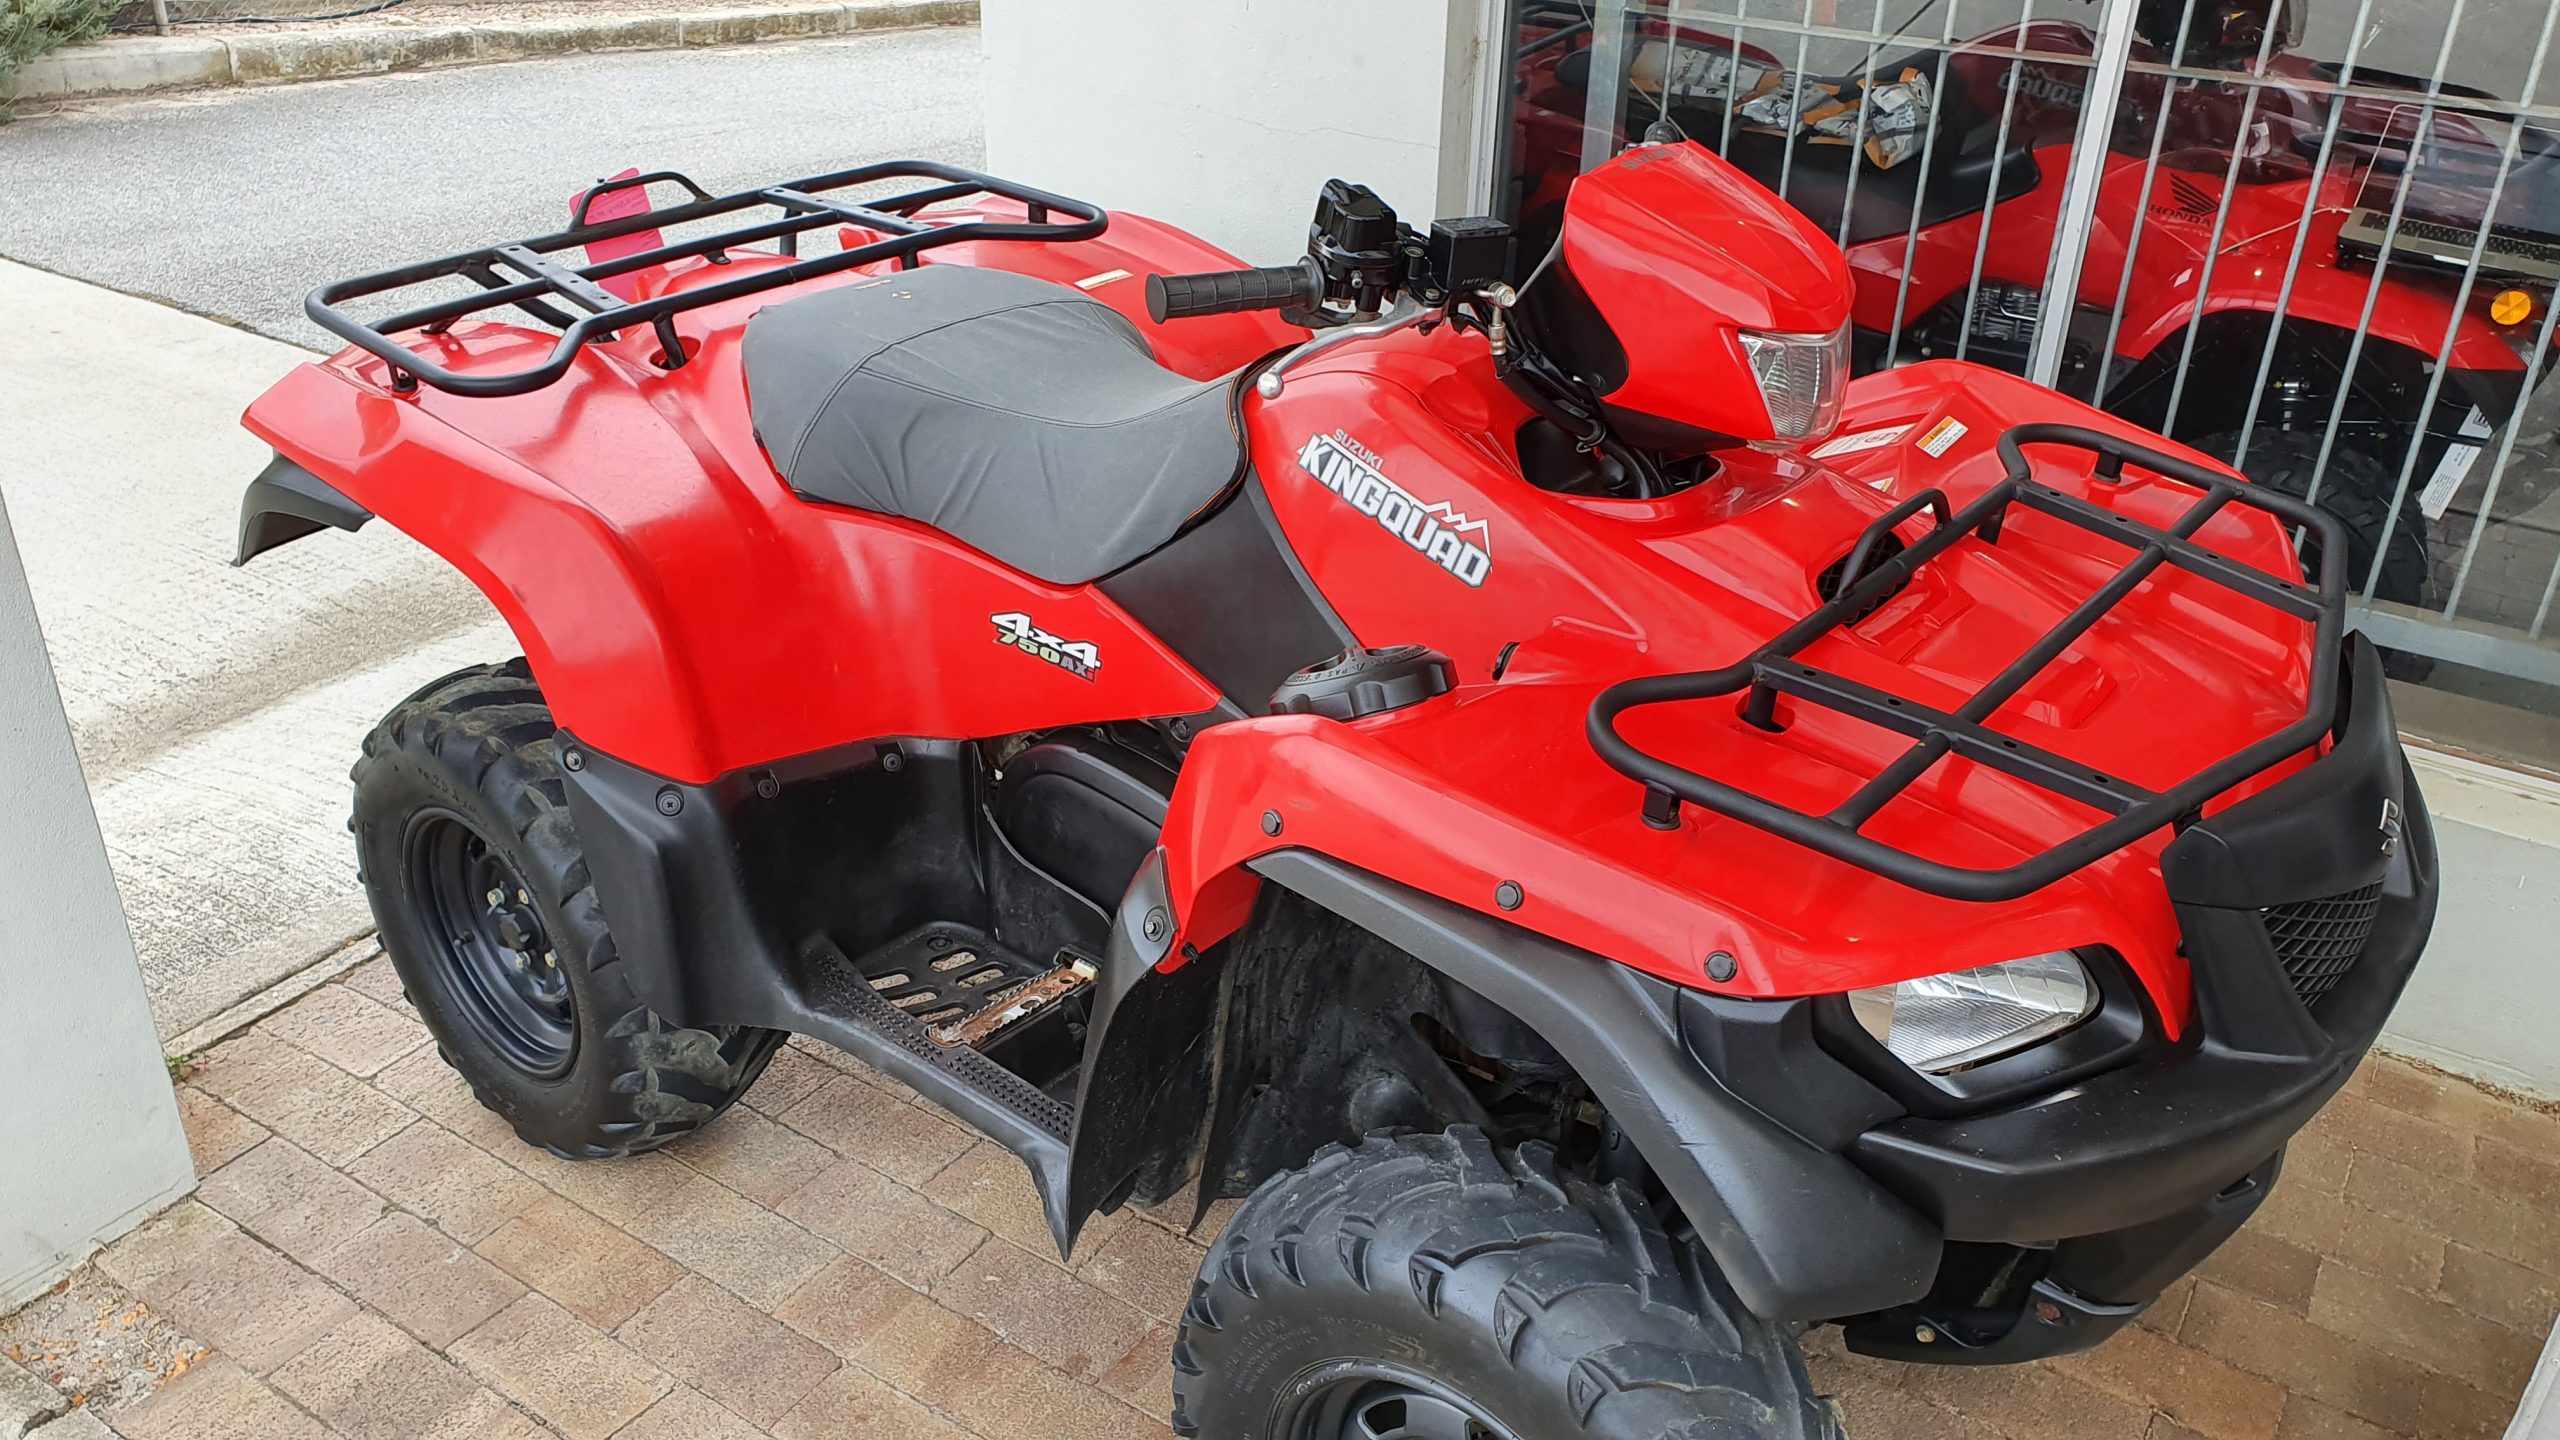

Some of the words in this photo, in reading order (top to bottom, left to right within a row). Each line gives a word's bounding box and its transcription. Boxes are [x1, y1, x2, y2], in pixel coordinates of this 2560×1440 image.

[2149, 203, 2211, 228] HONDA
[1333, 428, 1384, 471] SUZUKI
[1297, 432, 1491, 588] KINGQUAD
